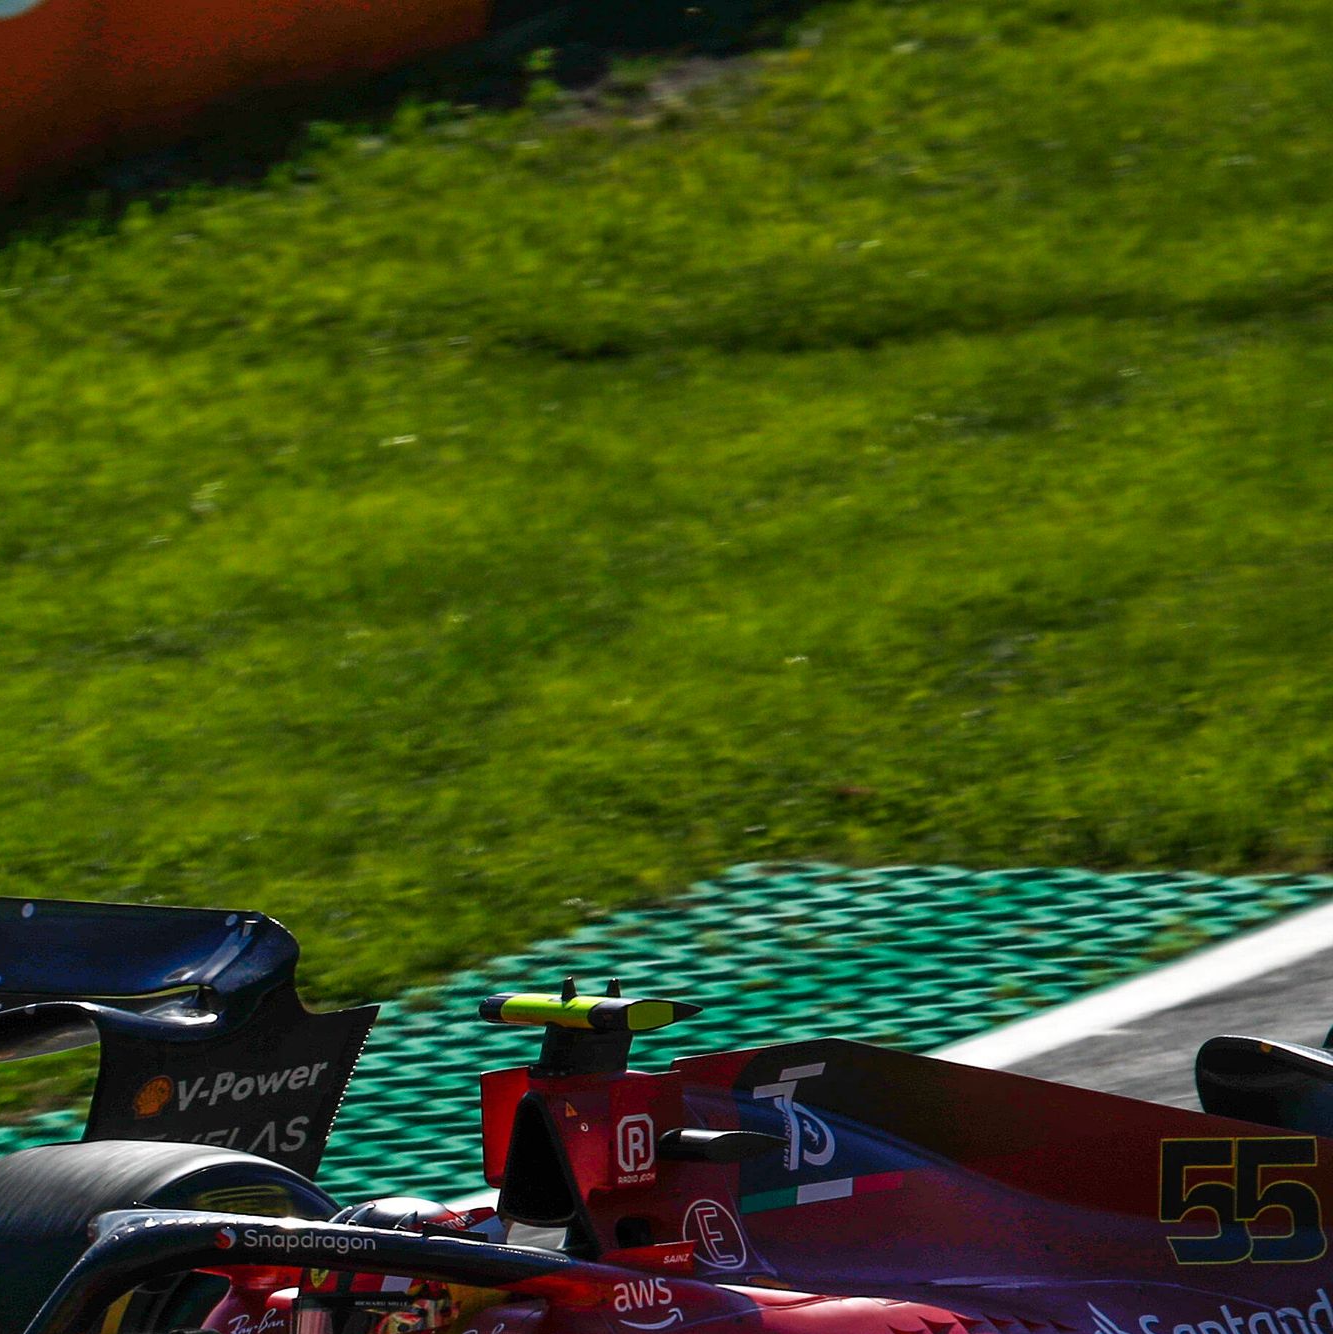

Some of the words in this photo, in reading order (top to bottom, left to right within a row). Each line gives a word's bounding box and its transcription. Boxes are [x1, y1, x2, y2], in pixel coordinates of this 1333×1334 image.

[177, 1061, 328, 1112] V-Power
[176, 1115, 310, 1152] ELAS
[1159, 1136, 1328, 1265] 55
[243, 1229, 376, 1255] Snapdragon
[663, 1252, 690, 1264] SAINZ
[614, 1275, 673, 1314] aws
